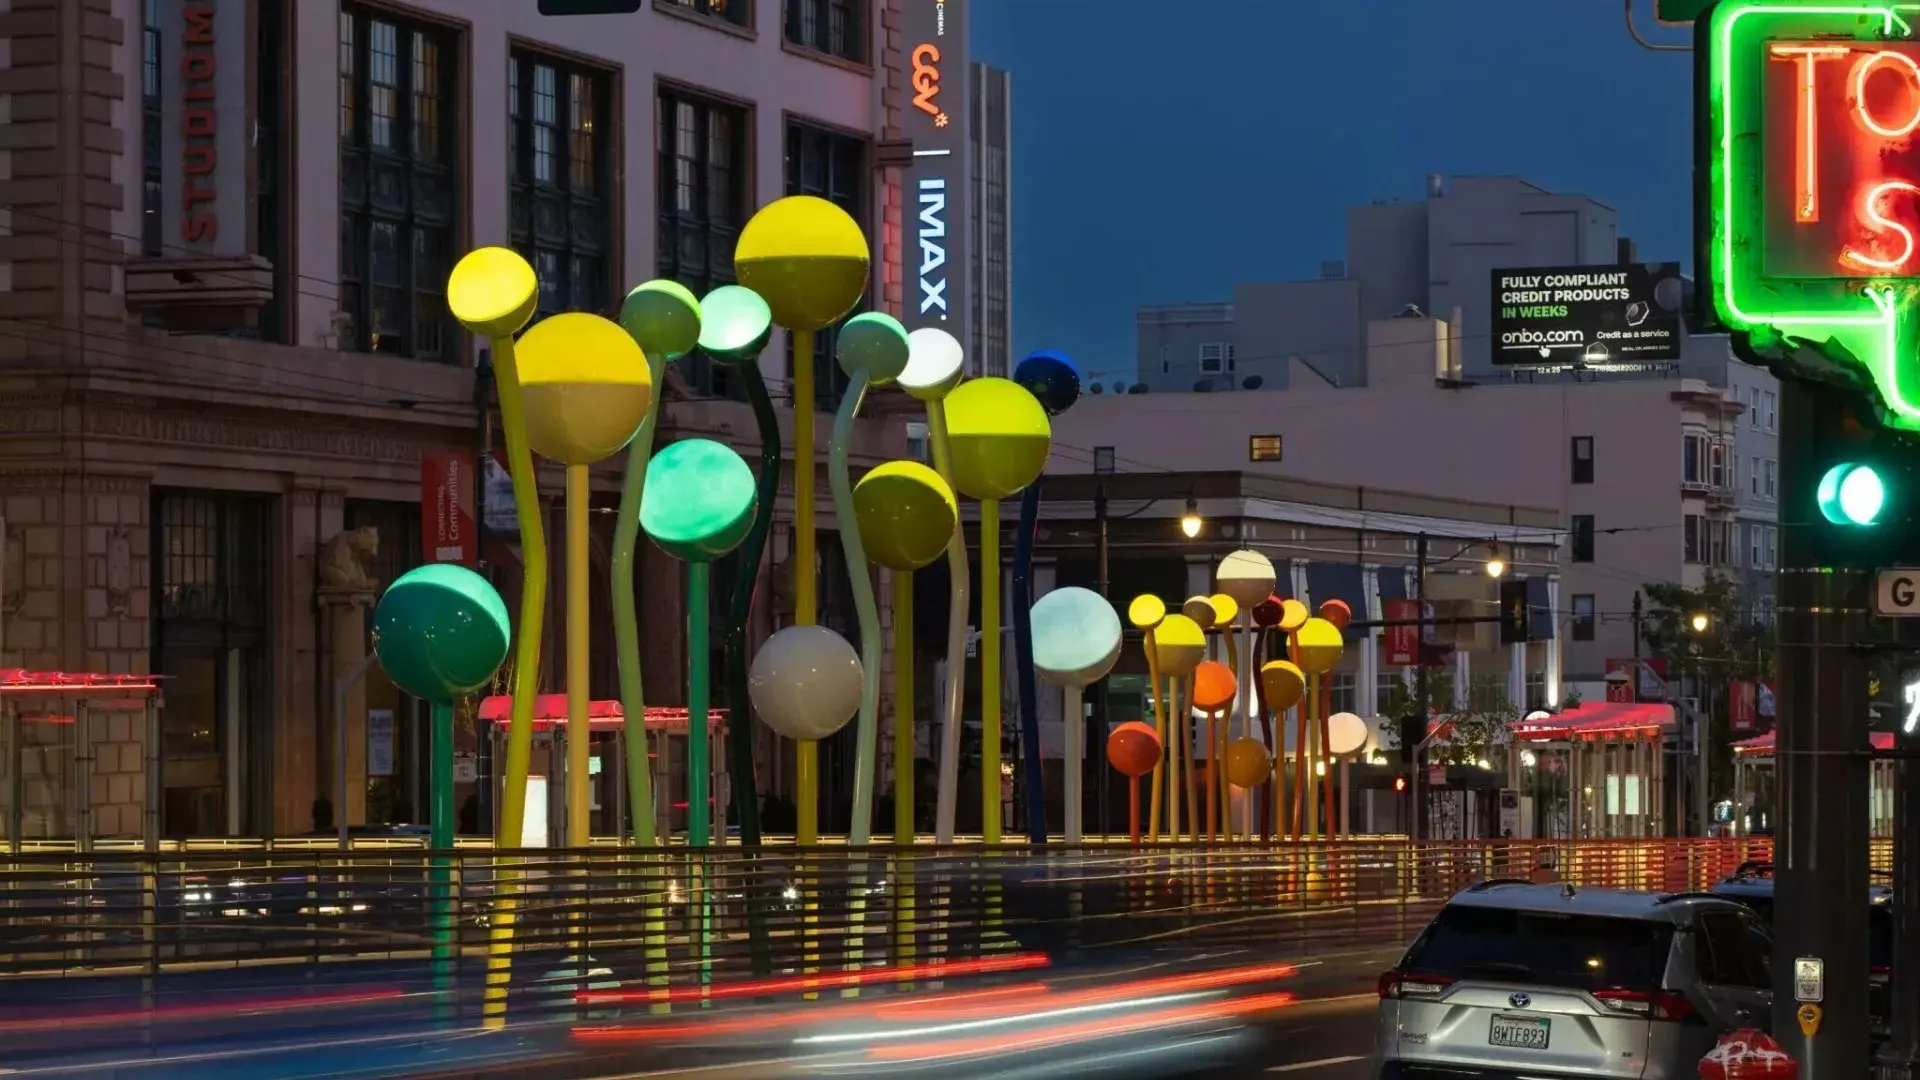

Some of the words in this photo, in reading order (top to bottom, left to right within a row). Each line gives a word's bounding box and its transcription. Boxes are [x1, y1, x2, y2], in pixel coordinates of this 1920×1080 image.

[936, 3, 944, 36] CINEMAS
[911, 42, 940, 115] CGV
[918, 179, 946, 315] IMAX
[1501, 276, 1541, 288] FULLY
[1544, 273, 1627, 288] COMPLIANT
[1501, 291, 1552, 303] CREDIT
[1554, 288, 1630, 302] PRODUCTS
[1502, 306, 1516, 318] IN
[1519, 305, 1568, 318] WEEKS
[1501, 328, 1584, 343] onbo.com
[1597, 330, 1621, 339] Credit
[1641, 329, 1670, 338] service
[448, 459, 459, 540] Communities
[437, 485, 446, 540] CONNECTING
[1494, 1026, 1545, 1044] 8WTF893
